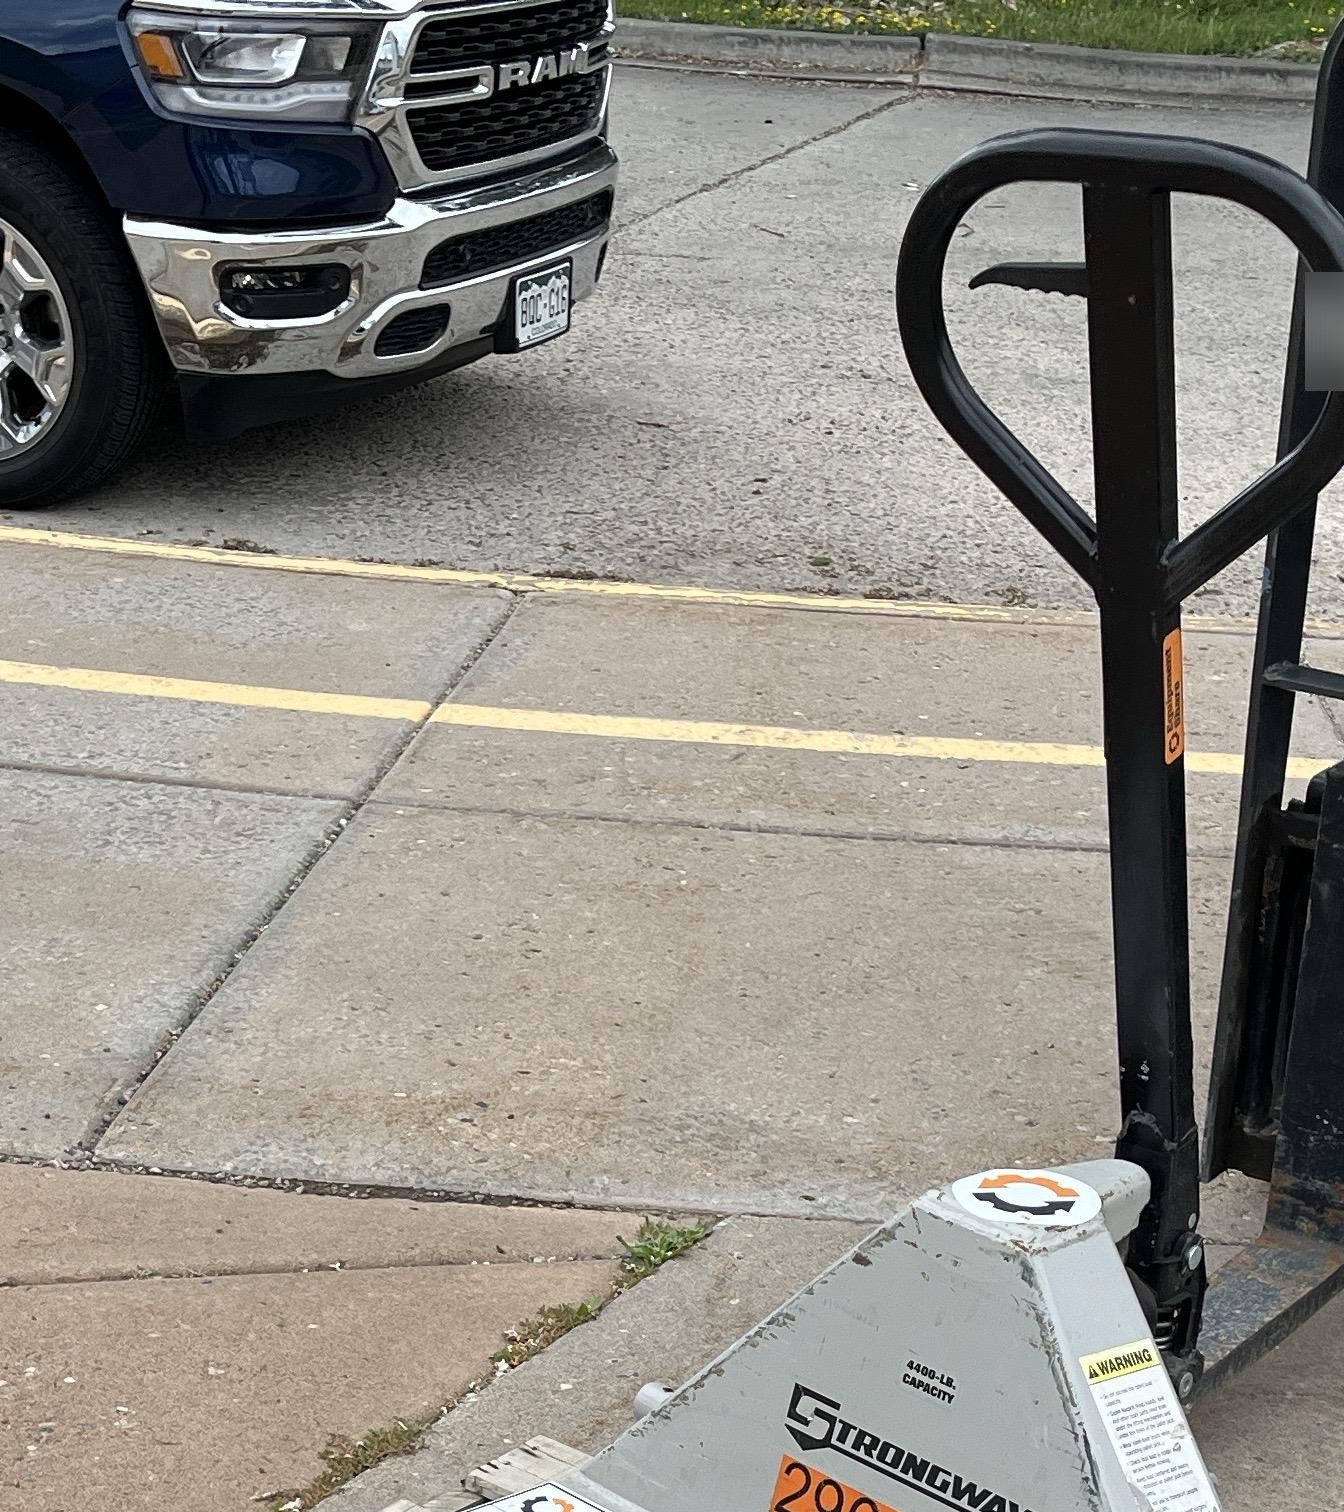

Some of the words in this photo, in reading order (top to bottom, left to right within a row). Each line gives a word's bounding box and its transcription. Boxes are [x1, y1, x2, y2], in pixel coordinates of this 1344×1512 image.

[498, 44, 588, 90] RAM
[906, 1359, 956, 1390] 4400-LB.
[1096, 1348, 1152, 1376] WARNING
[902, 1373, 955, 1404] CAPACITY
